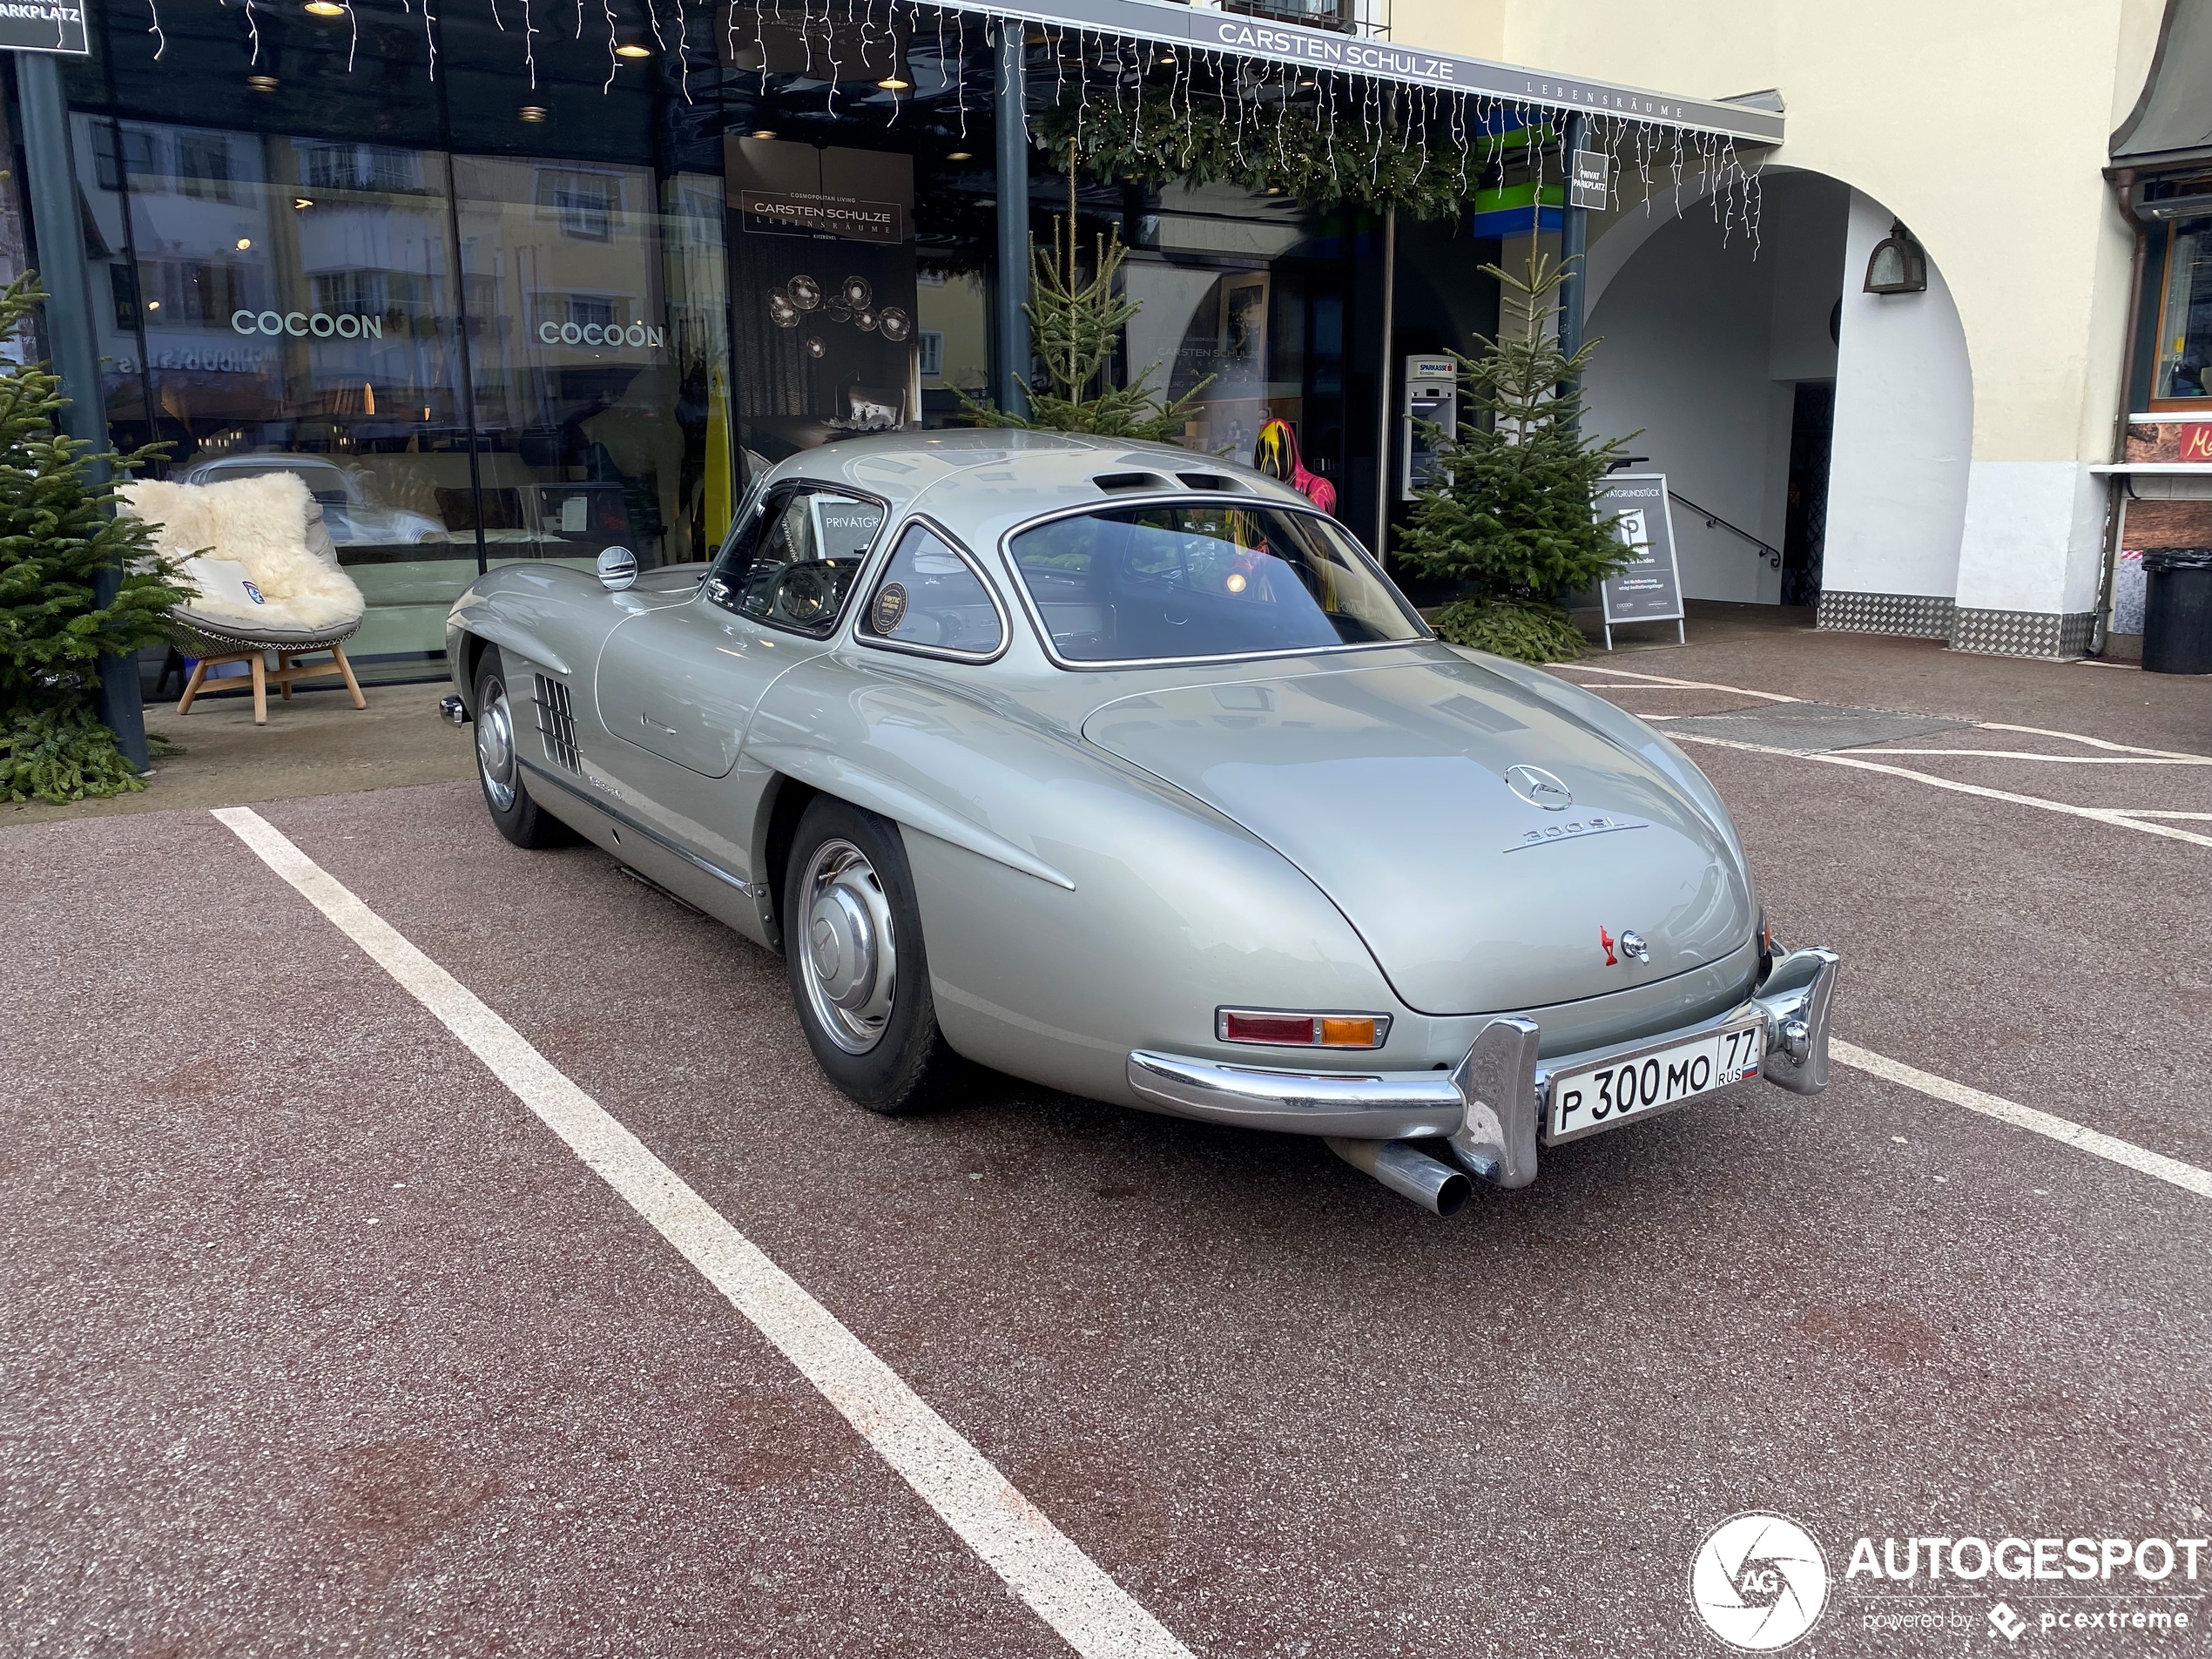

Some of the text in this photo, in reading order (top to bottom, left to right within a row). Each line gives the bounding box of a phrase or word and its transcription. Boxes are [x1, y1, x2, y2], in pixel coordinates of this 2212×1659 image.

[0, 3, 81, 23] ARKPLATZ
[1218, 24, 1453, 81] CARSTEN SCHULZE
[1527, 81, 1683, 118] LEBENSRÄUME
[1574, 179, 1606, 192] PARKPLATZ
[1581, 170, 1601, 181] PRIVAT
[790, 192, 836, 202] COSMOPOLITAN
[754, 202, 891, 223] CARSTEN SCHULZE
[756, 216, 891, 233] LEBENSRÄUME
[231, 309, 382, 340] COCOON
[538, 320, 664, 348] COCOON
[1157, 347, 1211, 357] CARSTEN
[1523, 816, 1630, 842] 300 SL
[1725, 1028, 1756, 1070] 77
[1718, 1068, 1742, 1085] RUS
